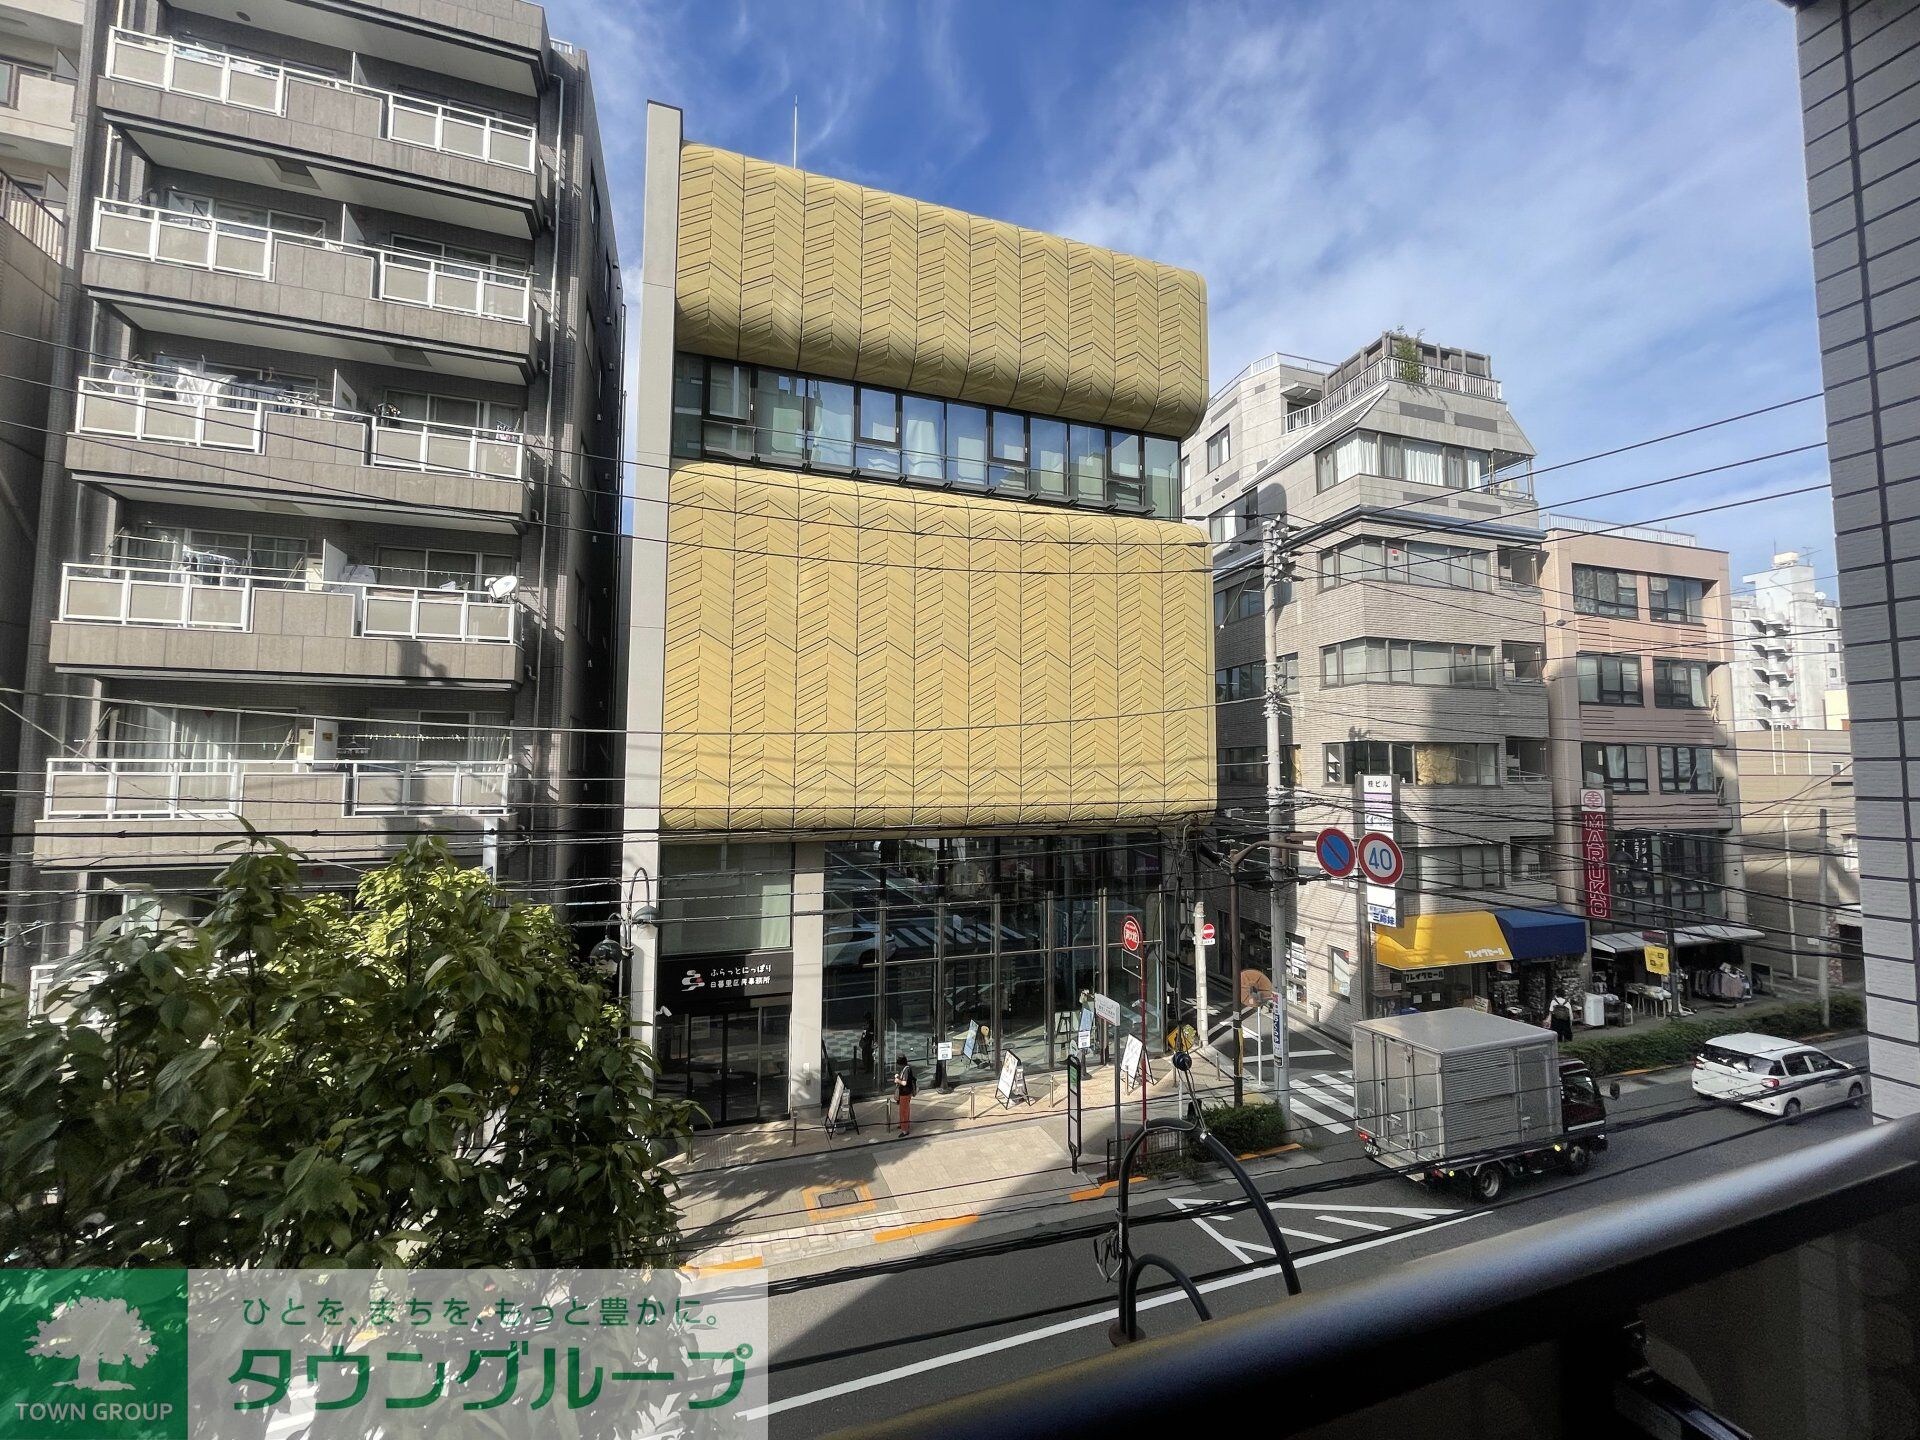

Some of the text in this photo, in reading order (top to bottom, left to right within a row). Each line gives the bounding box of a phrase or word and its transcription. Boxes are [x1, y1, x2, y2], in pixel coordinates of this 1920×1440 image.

[1368, 847, 1393, 871] 40
[1585, 814, 1607, 918] MARUKO
[710, 964, 772, 977] ふらっとにっぽり
